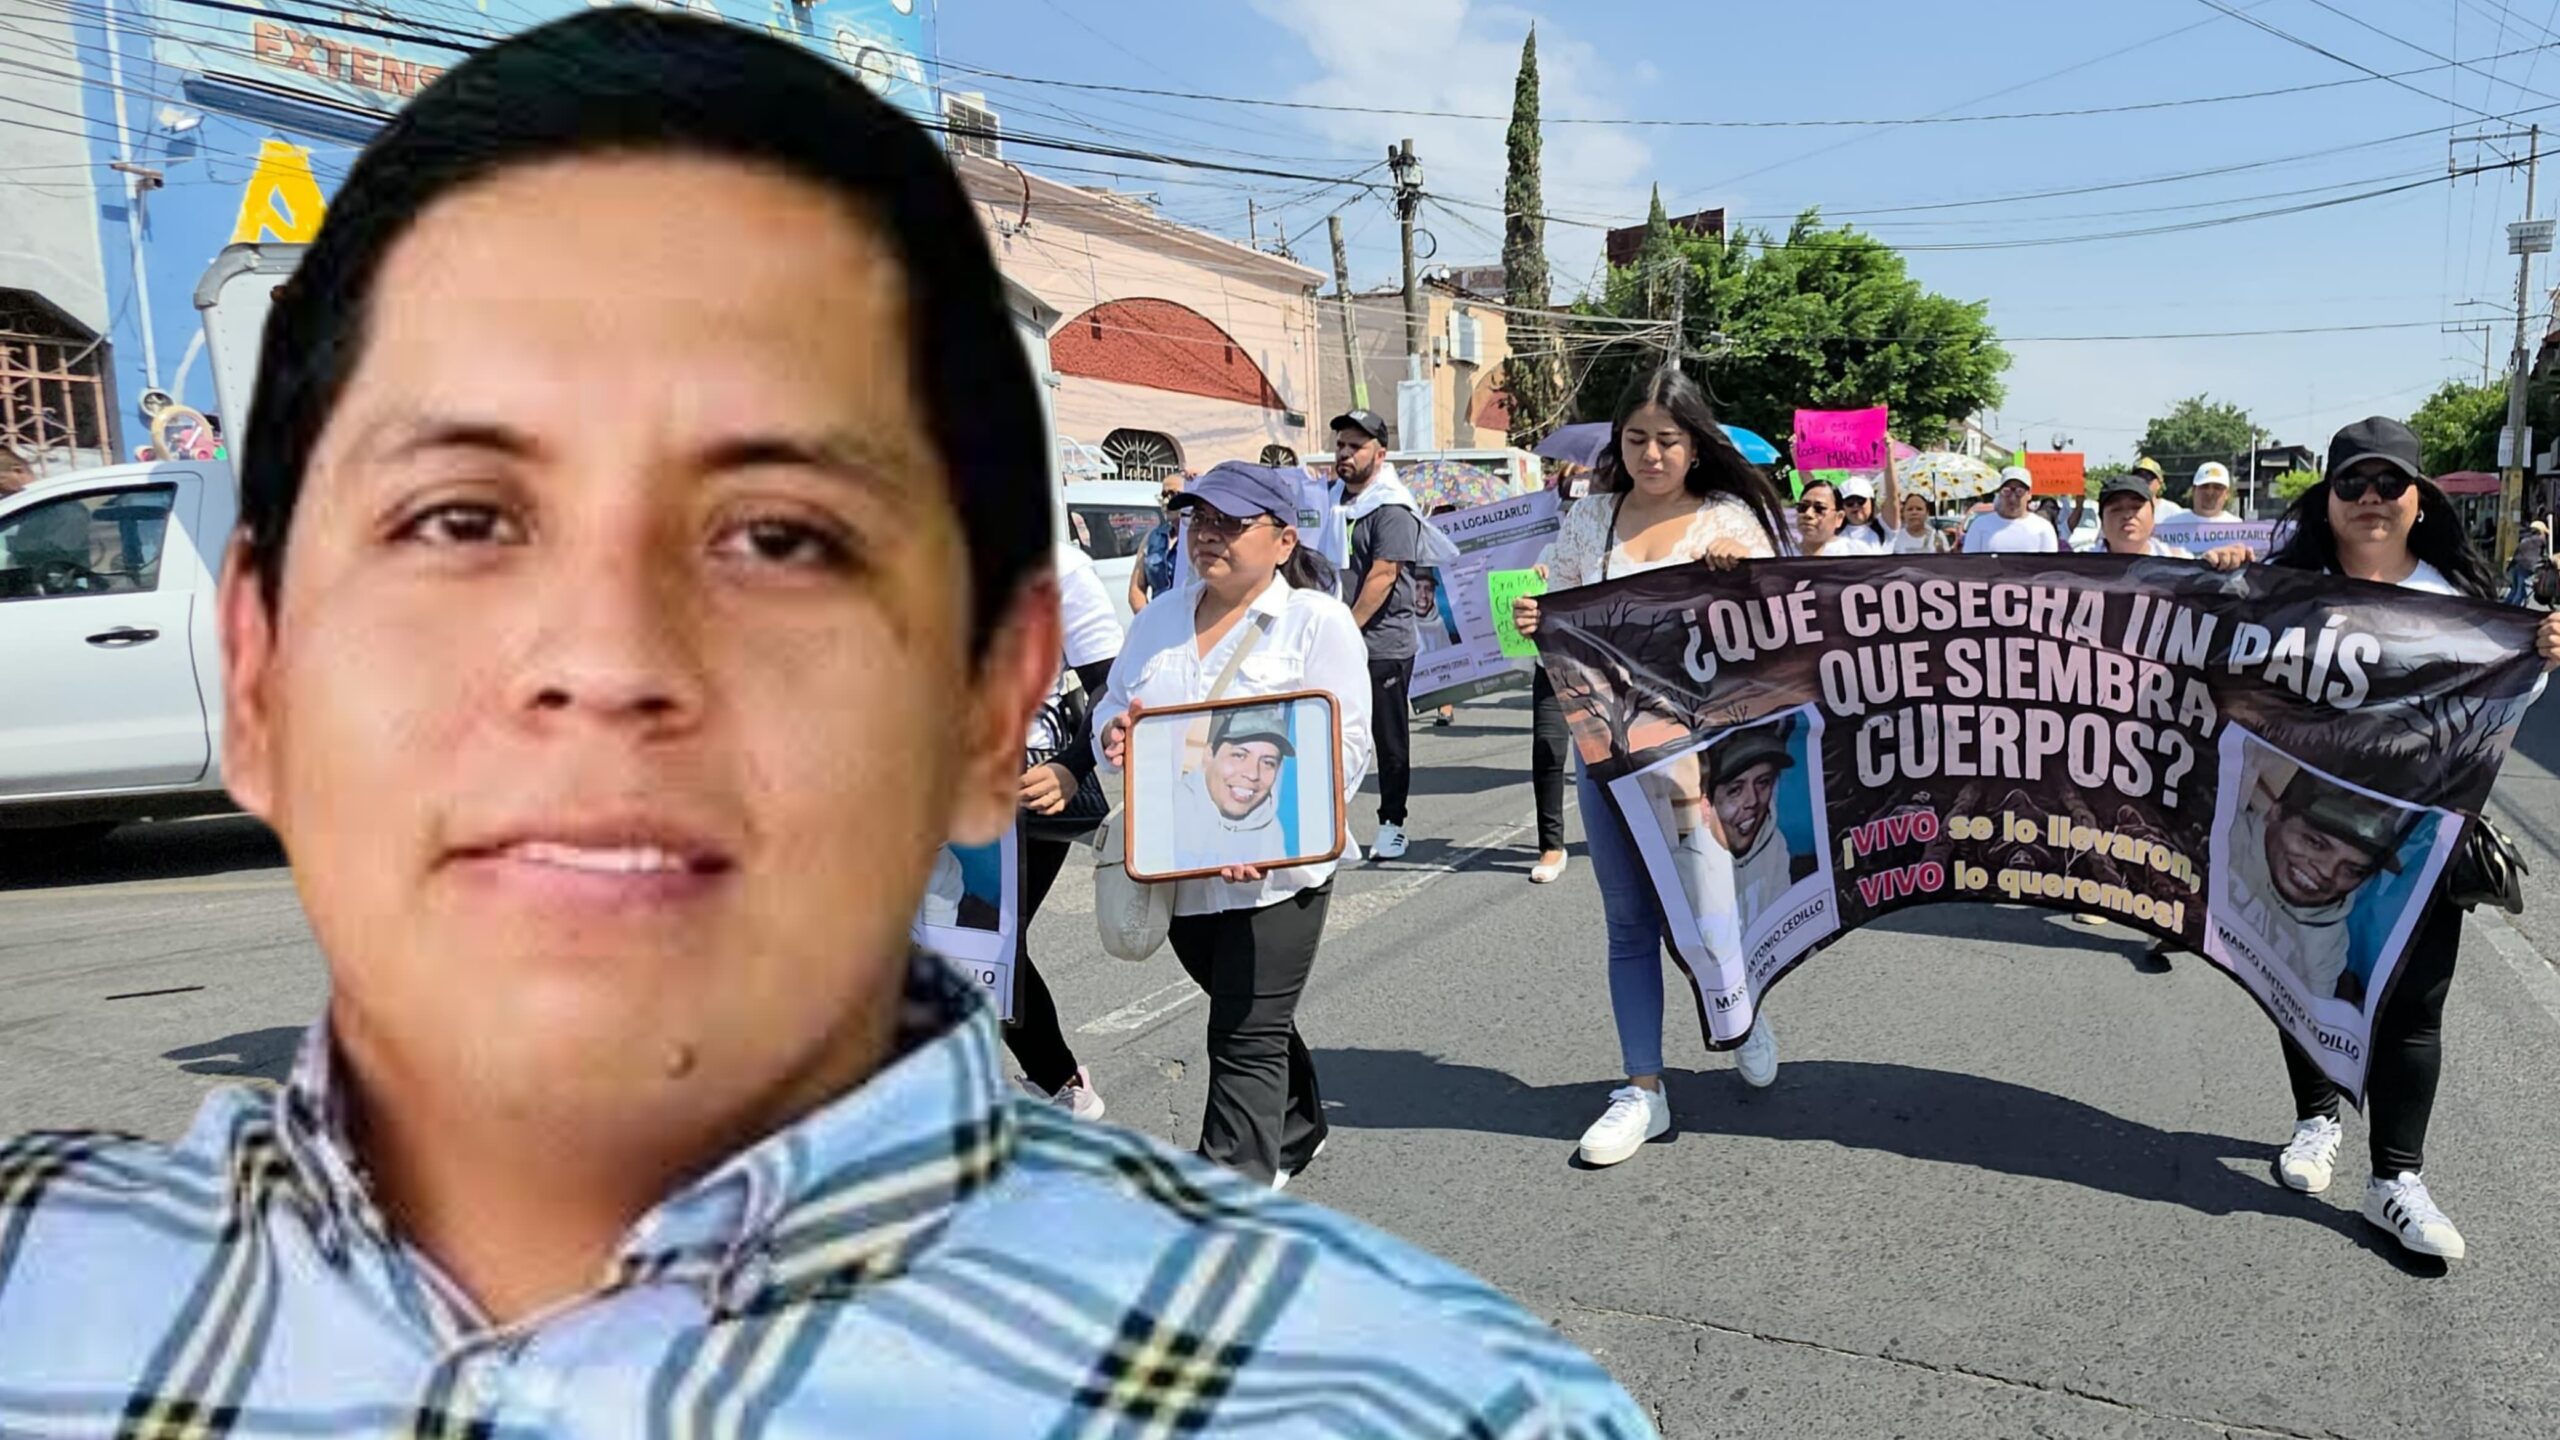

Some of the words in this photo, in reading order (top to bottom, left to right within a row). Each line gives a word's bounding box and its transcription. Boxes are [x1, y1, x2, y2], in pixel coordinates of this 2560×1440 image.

[1453, 522, 1461, 534] A
[1461, 503, 1532, 530] LOCALIZARLO!
[2194, 531, 2204, 543] A
[1682, 580, 1824, 683] ¿QUÉ
[1840, 580, 2105, 650] COSECHA
[2228, 613, 2381, 710] PAÍS
[1819, 640, 1934, 717] QUE
[1945, 637, 2218, 739] SIEMBRA
[1856, 704, 2194, 808] CUERPOS?
[1948, 815, 1994, 841] se
[2003, 810, 2038, 843] lo
[2048, 814, 2201, 895] llevaron,
[1747, 930, 1781, 974] ANTONIO
[1782, 899, 1825, 936] CEDILLO
[1857, 861, 1944, 907] VIVO
[1954, 860, 1989, 890] lo
[1997, 868, 2185, 935] queremos!
[2219, 926, 2259, 967] MARCO
[2261, 965, 2306, 1020] ANTONIO
[2270, 989, 2297, 1032] TAPIA
